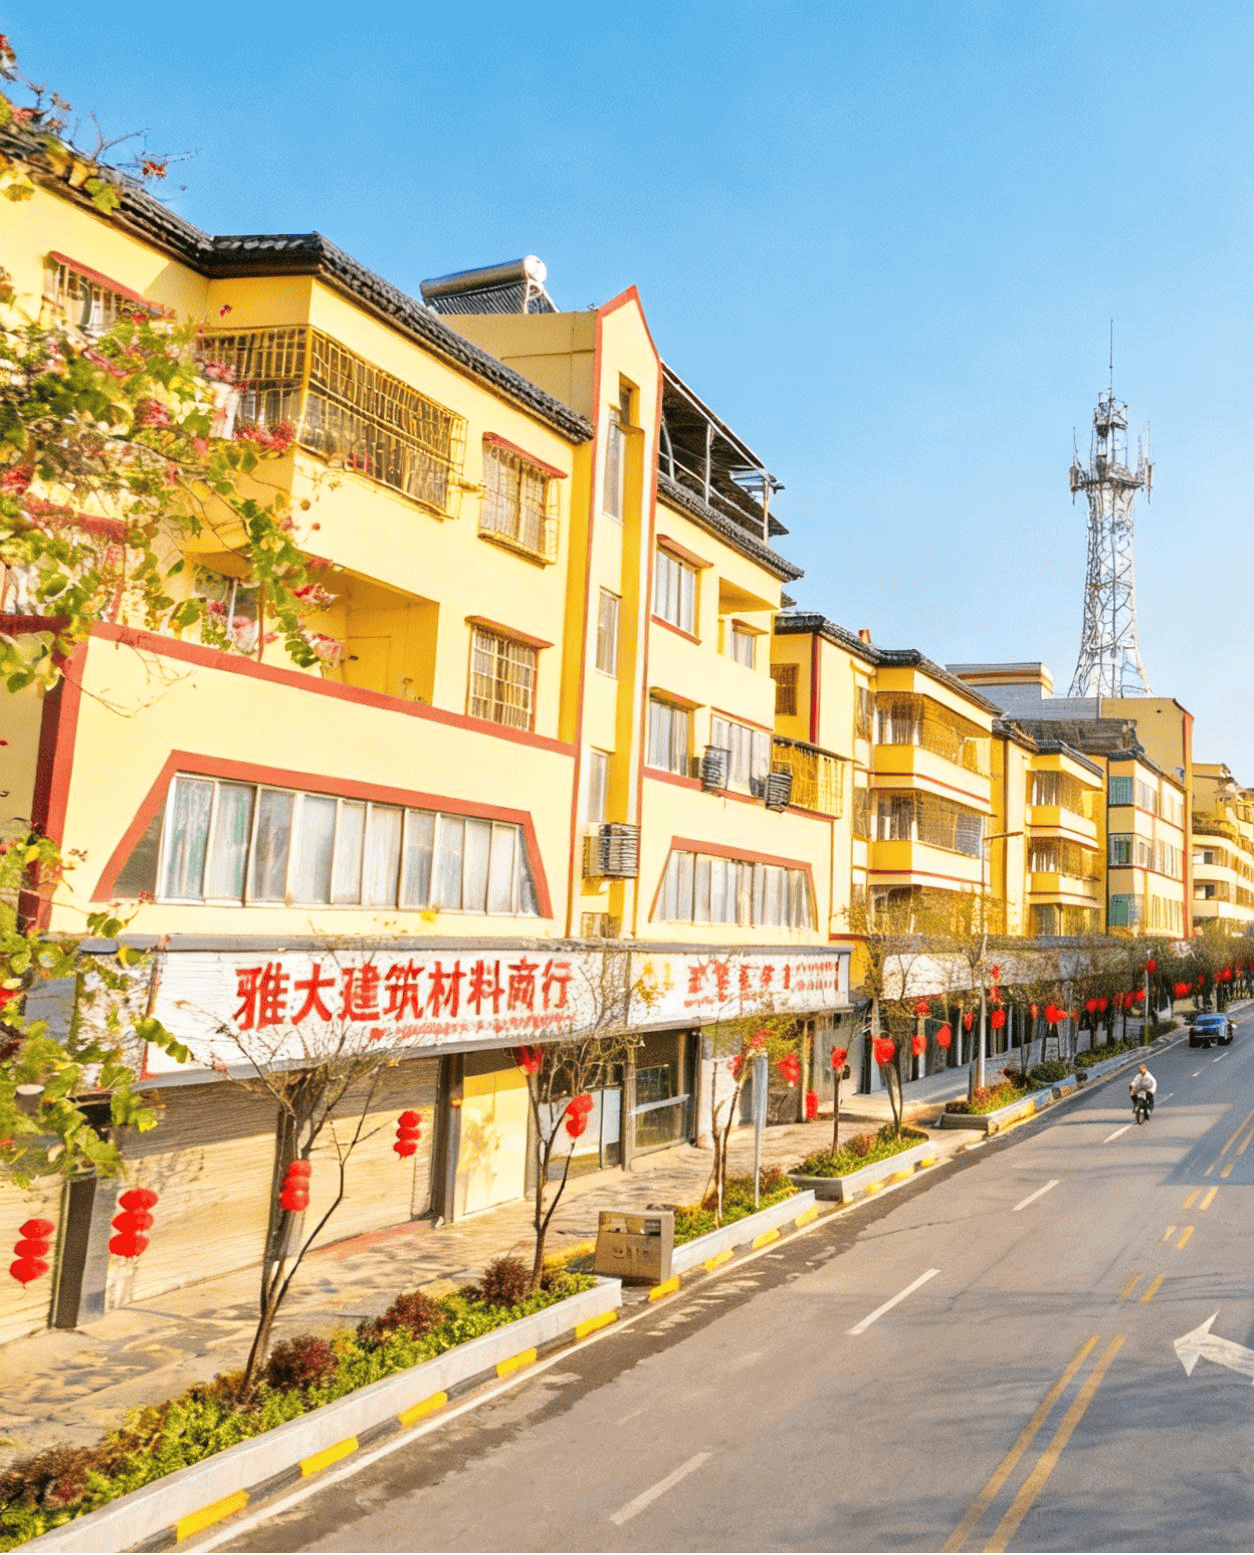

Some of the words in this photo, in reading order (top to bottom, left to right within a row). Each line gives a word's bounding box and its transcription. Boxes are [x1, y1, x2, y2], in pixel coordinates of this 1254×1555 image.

[233, 957, 574, 1031] 雅大建筑材料商行
